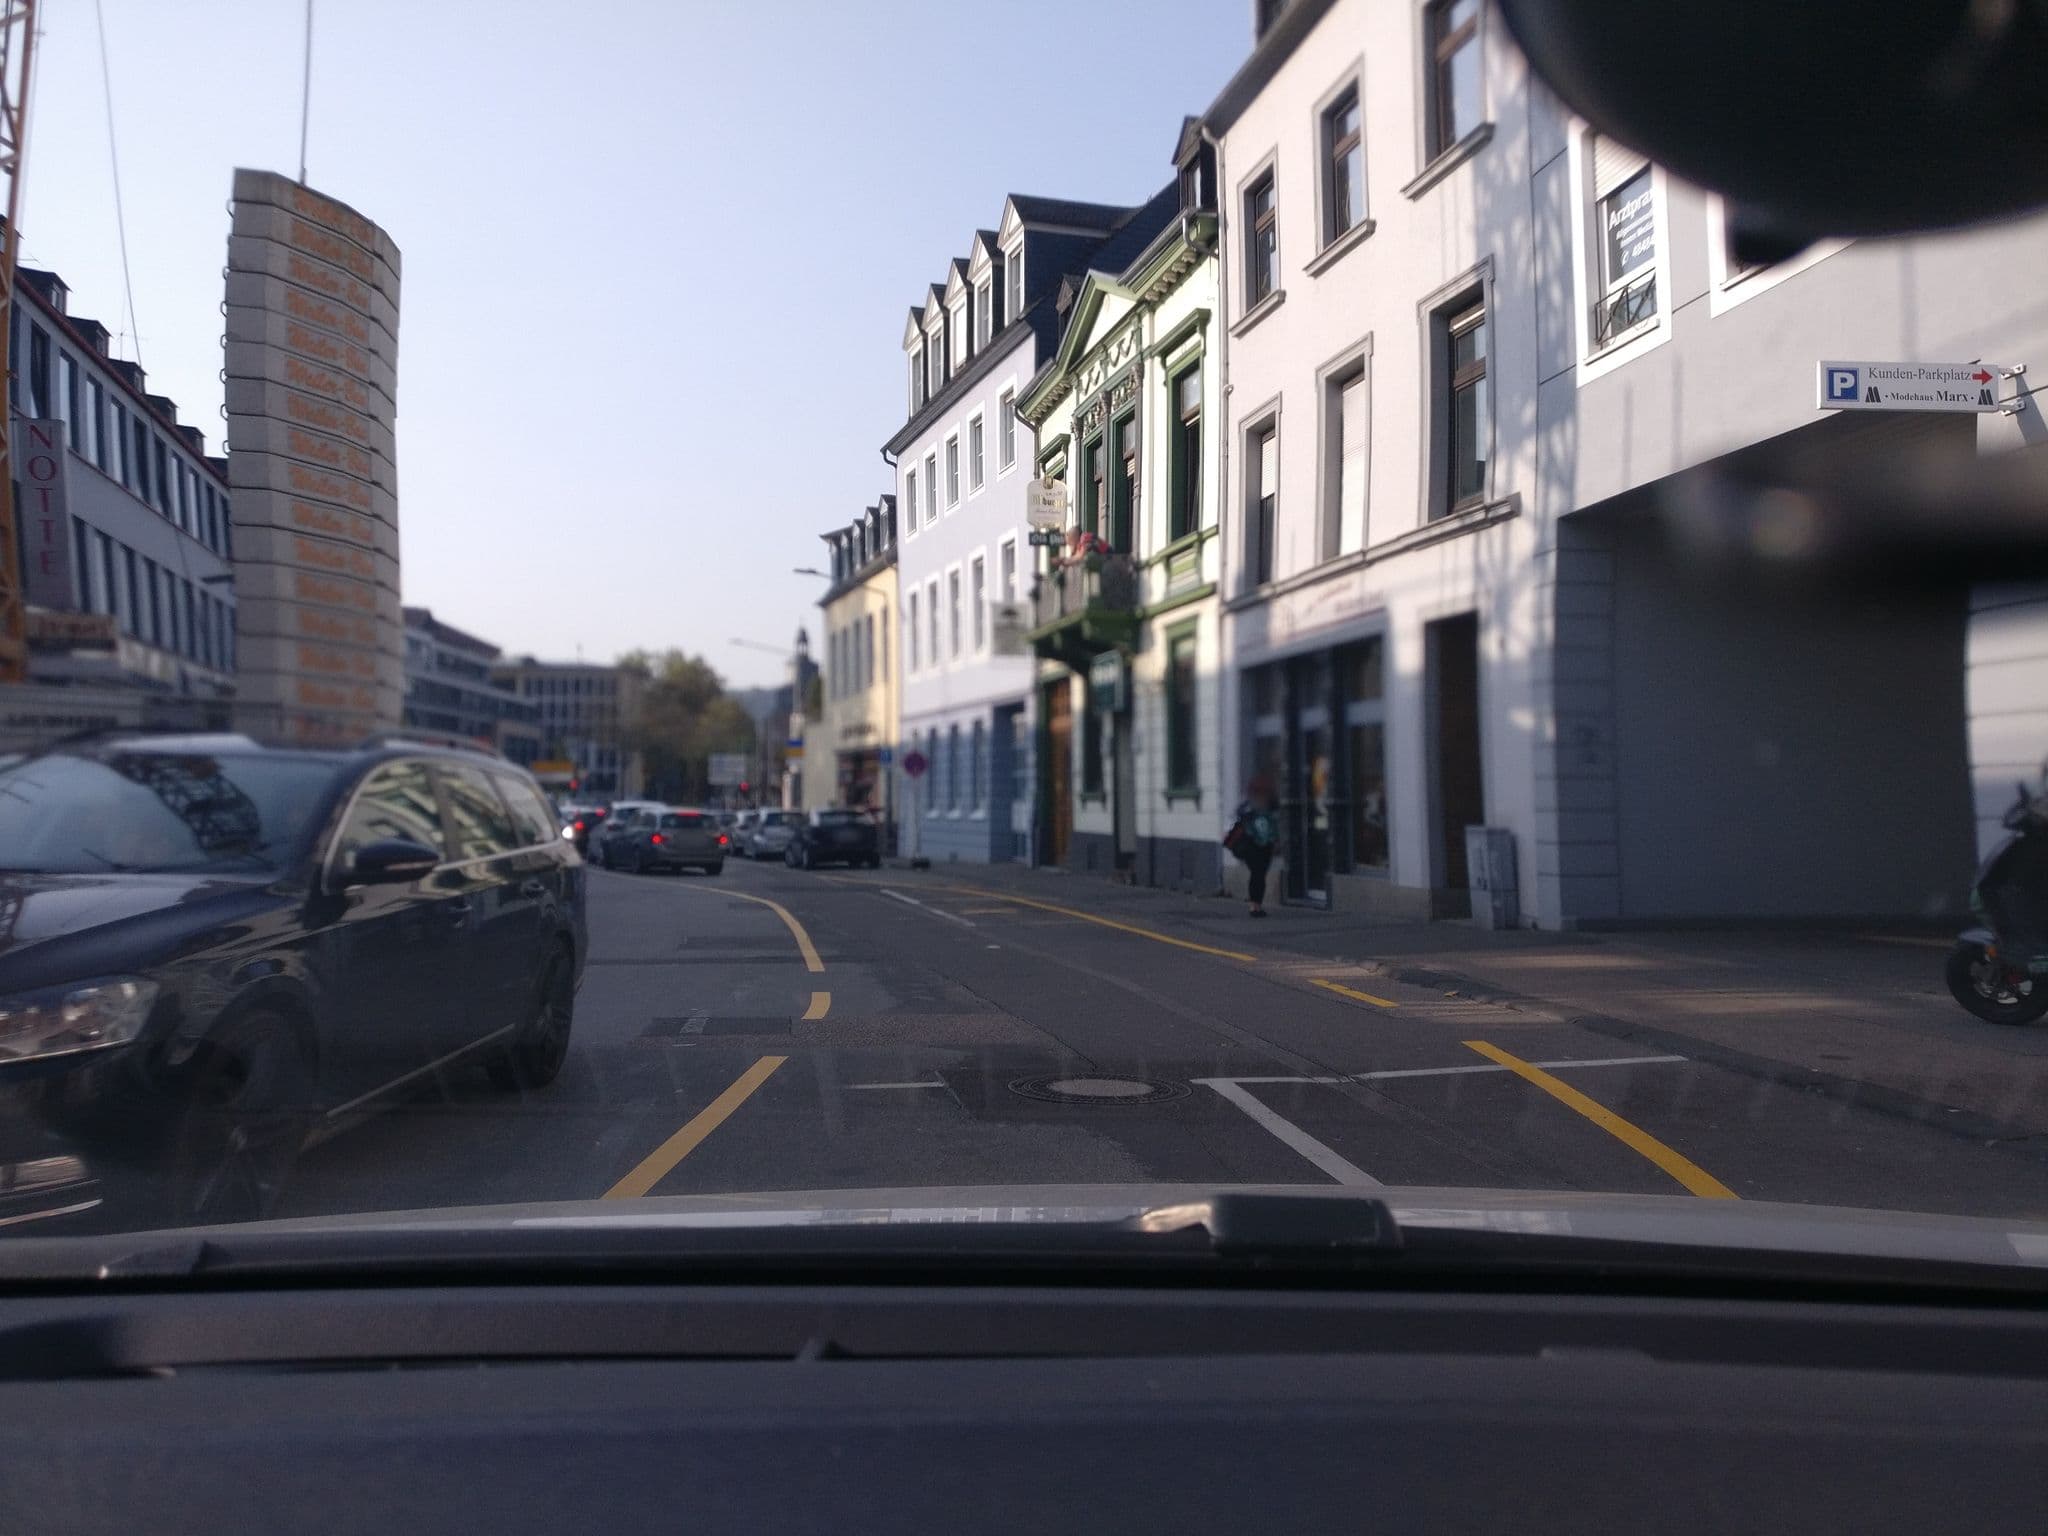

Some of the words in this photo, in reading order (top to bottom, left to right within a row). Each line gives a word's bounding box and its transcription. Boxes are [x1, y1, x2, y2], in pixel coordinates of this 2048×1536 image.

[1833, 371, 1855, 397] P
[1868, 367, 1971, 383] Kunden-Parkplatz
[1890, 391, 1935, 402] Modehaus
[1936, 390, 1969, 402] Marx
[27, 423, 58, 577] NOTTE
